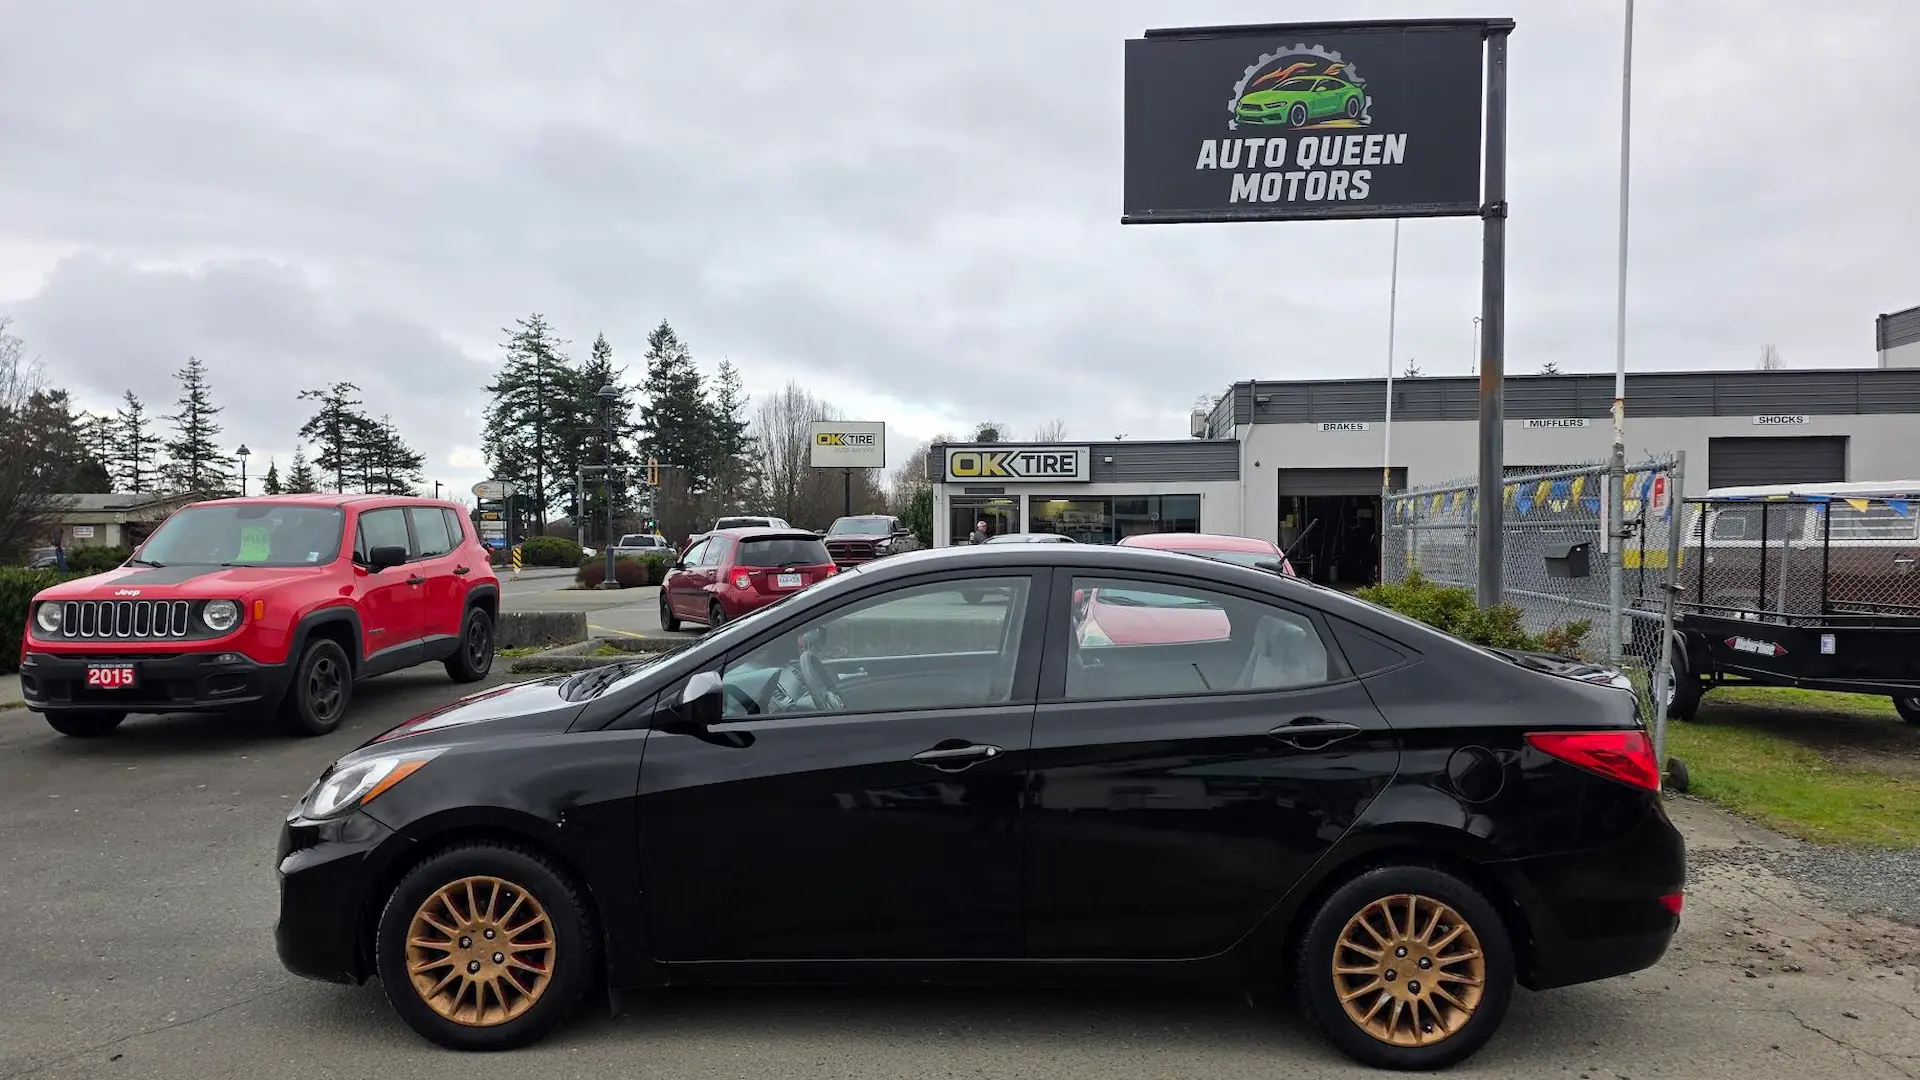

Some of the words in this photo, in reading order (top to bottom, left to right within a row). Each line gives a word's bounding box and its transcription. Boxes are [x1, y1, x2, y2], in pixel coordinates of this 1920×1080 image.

[1196, 137, 1287, 170] AUTO
[1296, 133, 1408, 170] QUEEN
[1229, 169, 1372, 203] MOTORS
[1529, 419, 1584, 427] MUFFLERS
[1759, 416, 1804, 424] SHOCKS
[1323, 423, 1364, 431] BRAKES
[817, 433, 845, 446] OK
[848, 435, 873, 444] TIRE
[951, 451, 1014, 477] OK
[1020, 454, 1074, 473] TIRE
[114, 589, 141, 597] Jeep
[89, 668, 133, 684] 2015
